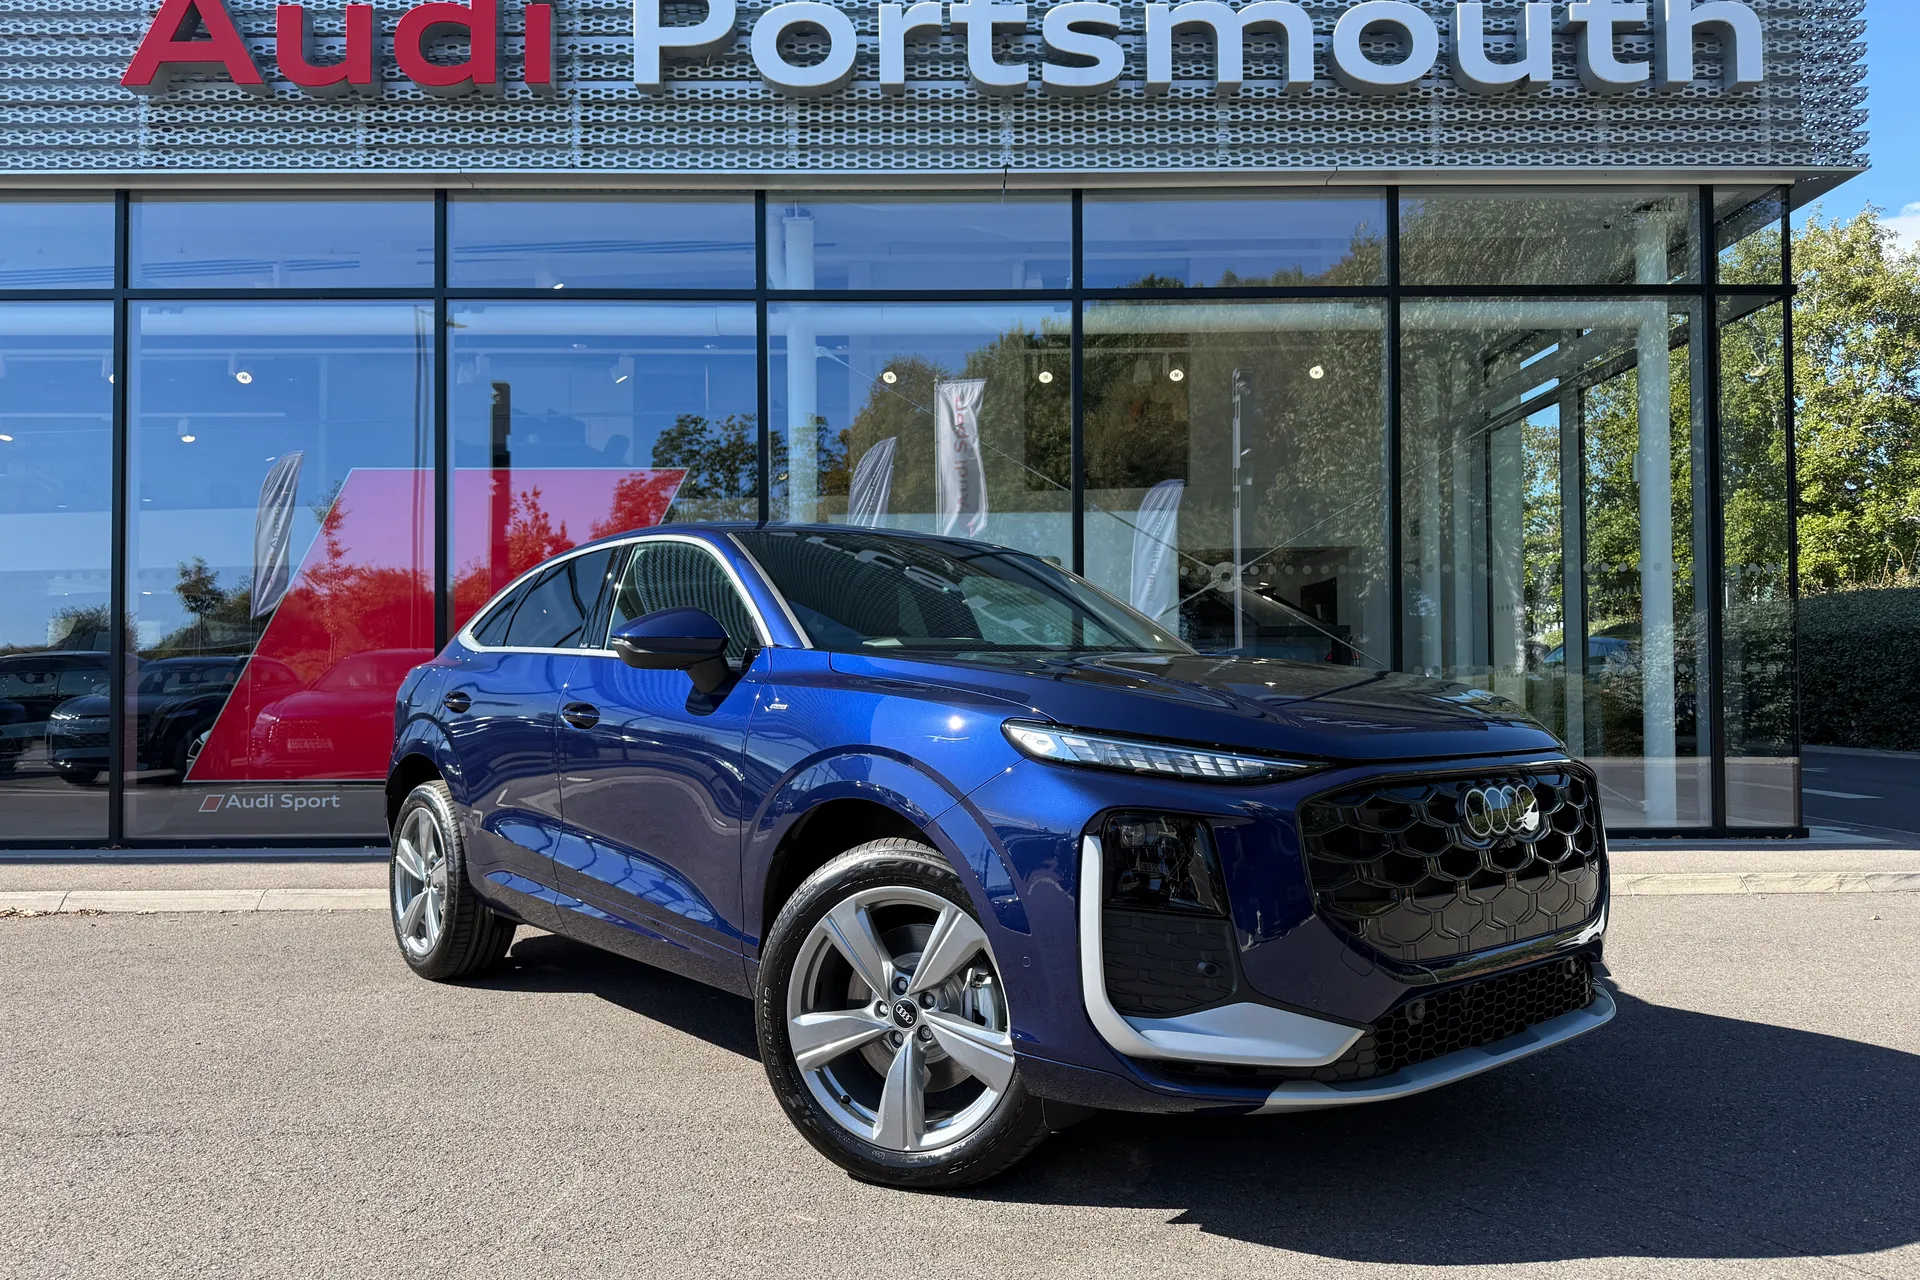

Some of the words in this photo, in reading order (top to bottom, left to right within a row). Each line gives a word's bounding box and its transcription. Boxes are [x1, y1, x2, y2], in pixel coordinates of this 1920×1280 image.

[121, 0, 555, 90] Audi
[633, 0, 1766, 88] Portsmouth
[225, 794, 274, 809] Audi
[280, 794, 340, 812] Sport
